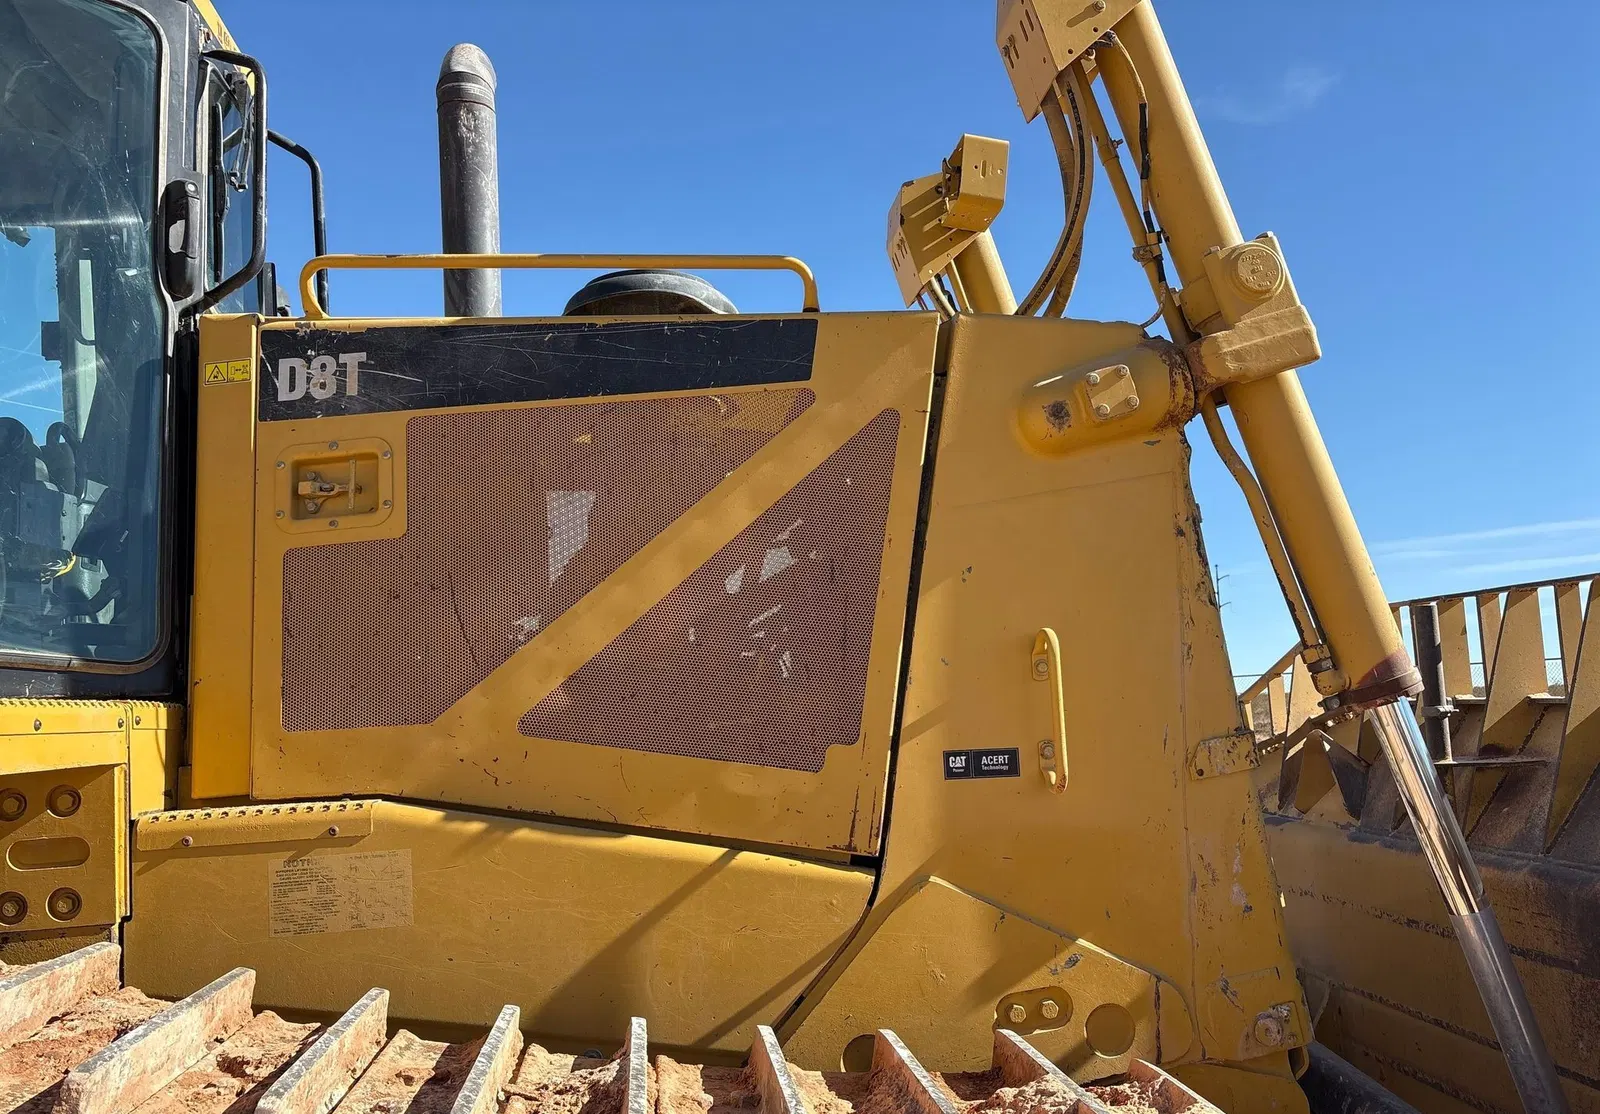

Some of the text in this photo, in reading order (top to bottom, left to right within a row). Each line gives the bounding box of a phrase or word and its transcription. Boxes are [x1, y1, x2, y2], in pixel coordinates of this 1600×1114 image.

[277, 352, 367, 401] D8T
[949, 756, 966, 768] CAT
[981, 755, 1009, 765] ACERT
